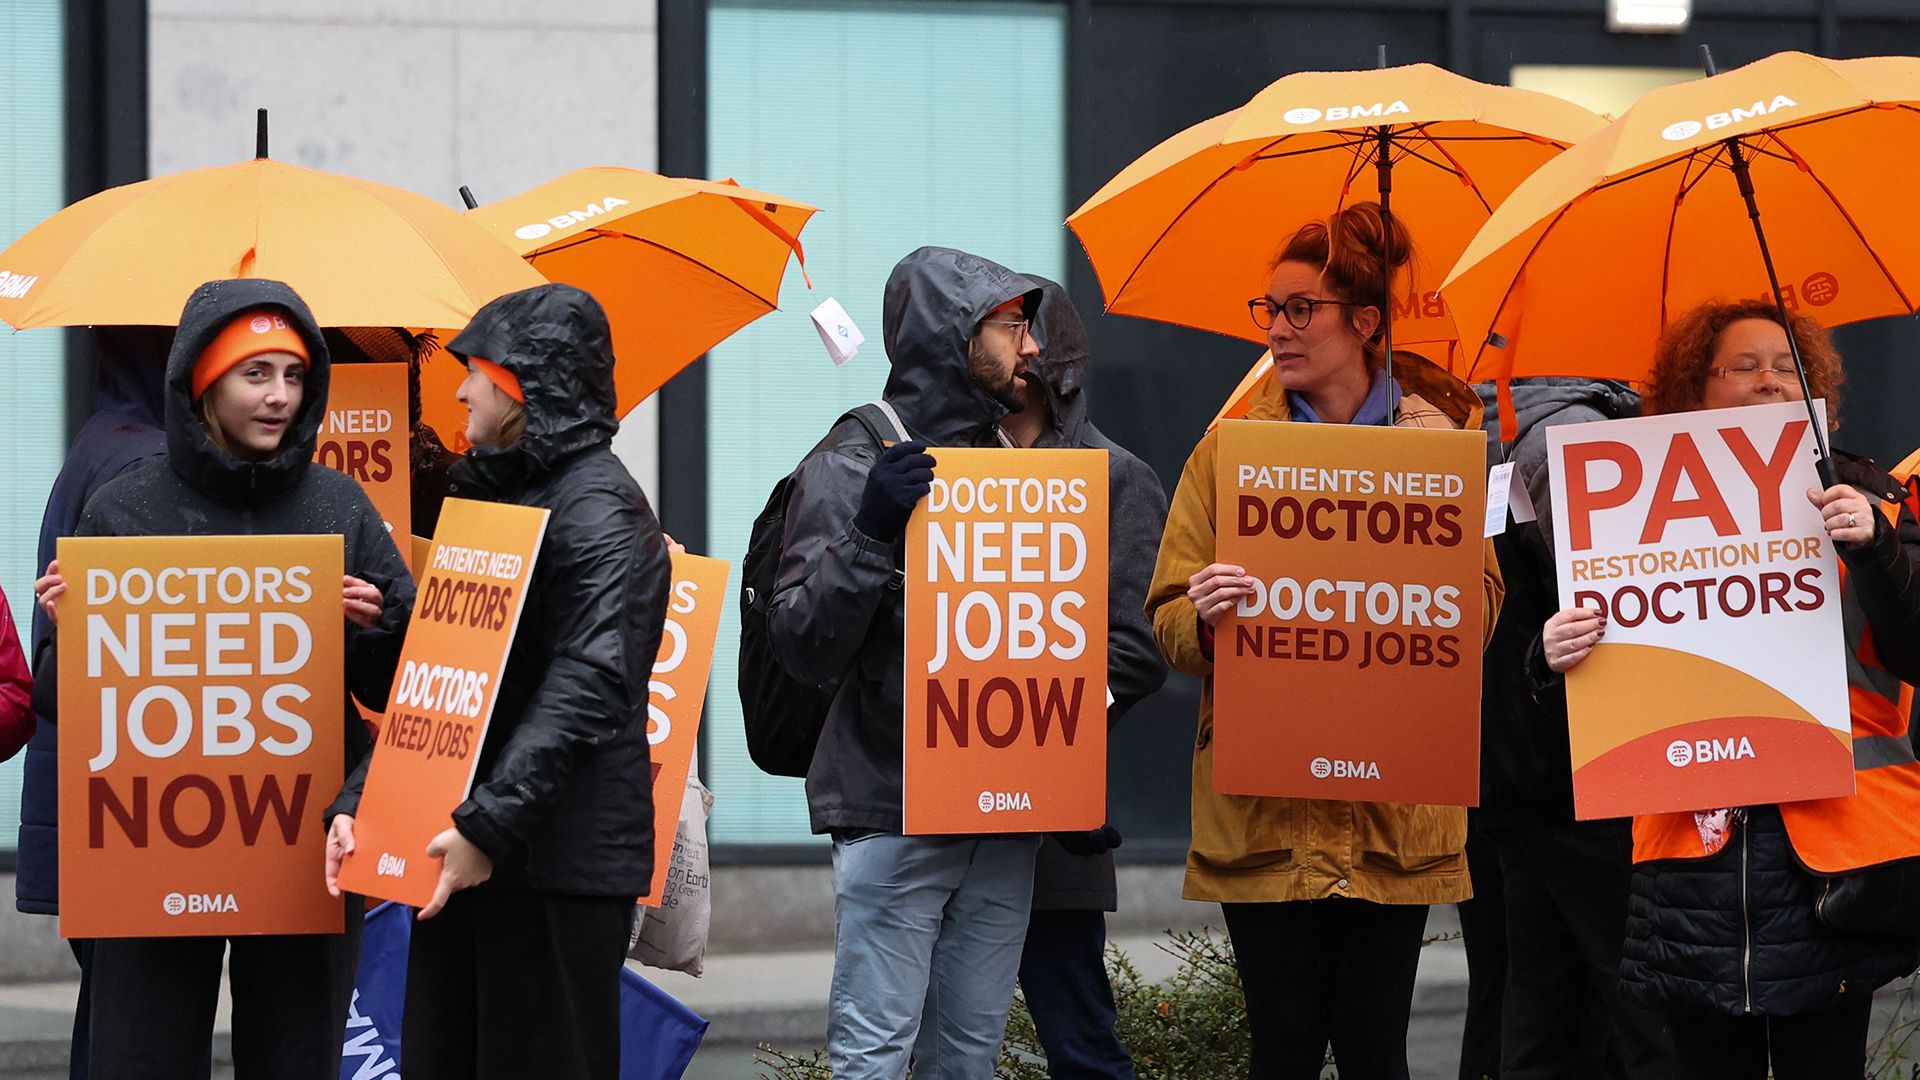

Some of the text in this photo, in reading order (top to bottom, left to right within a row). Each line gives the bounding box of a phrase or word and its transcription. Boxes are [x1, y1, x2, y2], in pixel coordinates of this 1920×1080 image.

[1325, 100, 1410, 121] BMA
[1705, 95, 1798, 130] BMA
[547, 196, 630, 230] BMA
[0, 274, 39, 299] BMA
[329, 409, 393, 434] NEED
[927, 477, 1088, 514] DOCTORS
[1238, 464, 1376, 495] PATIENTS
[1383, 471, 1464, 498] NEED
[1562, 420, 1810, 552] PAY
[1237, 494, 1463, 548] DOCTORS
[432, 544, 523, 581] PATIENTS NEED
[927, 521, 1088, 583] NEED
[1571, 536, 1823, 582] RESTORATION FOR
[86, 566, 313, 606] DOCTORS
[419, 576, 513, 632] DOCTORS
[1236, 576, 1462, 629] DOCTORS
[87, 612, 313, 678] NEED
[926, 590, 1087, 674] JOBS
[1236, 624, 1461, 670] NEED JOBS
[395, 659, 489, 719] DOCTORS
[88, 683, 313, 772] JOBS
[926, 676, 1086, 749] NOW
[384, 711, 474, 761] NEED JOBS
[1695, 735, 1756, 764] BMA
[1333, 759, 1381, 780] BMA
[88, 773, 312, 849] NOW
[995, 791, 1032, 811] BMA
[385, 854, 406, 878] BMA
[188, 893, 239, 913] BMA
